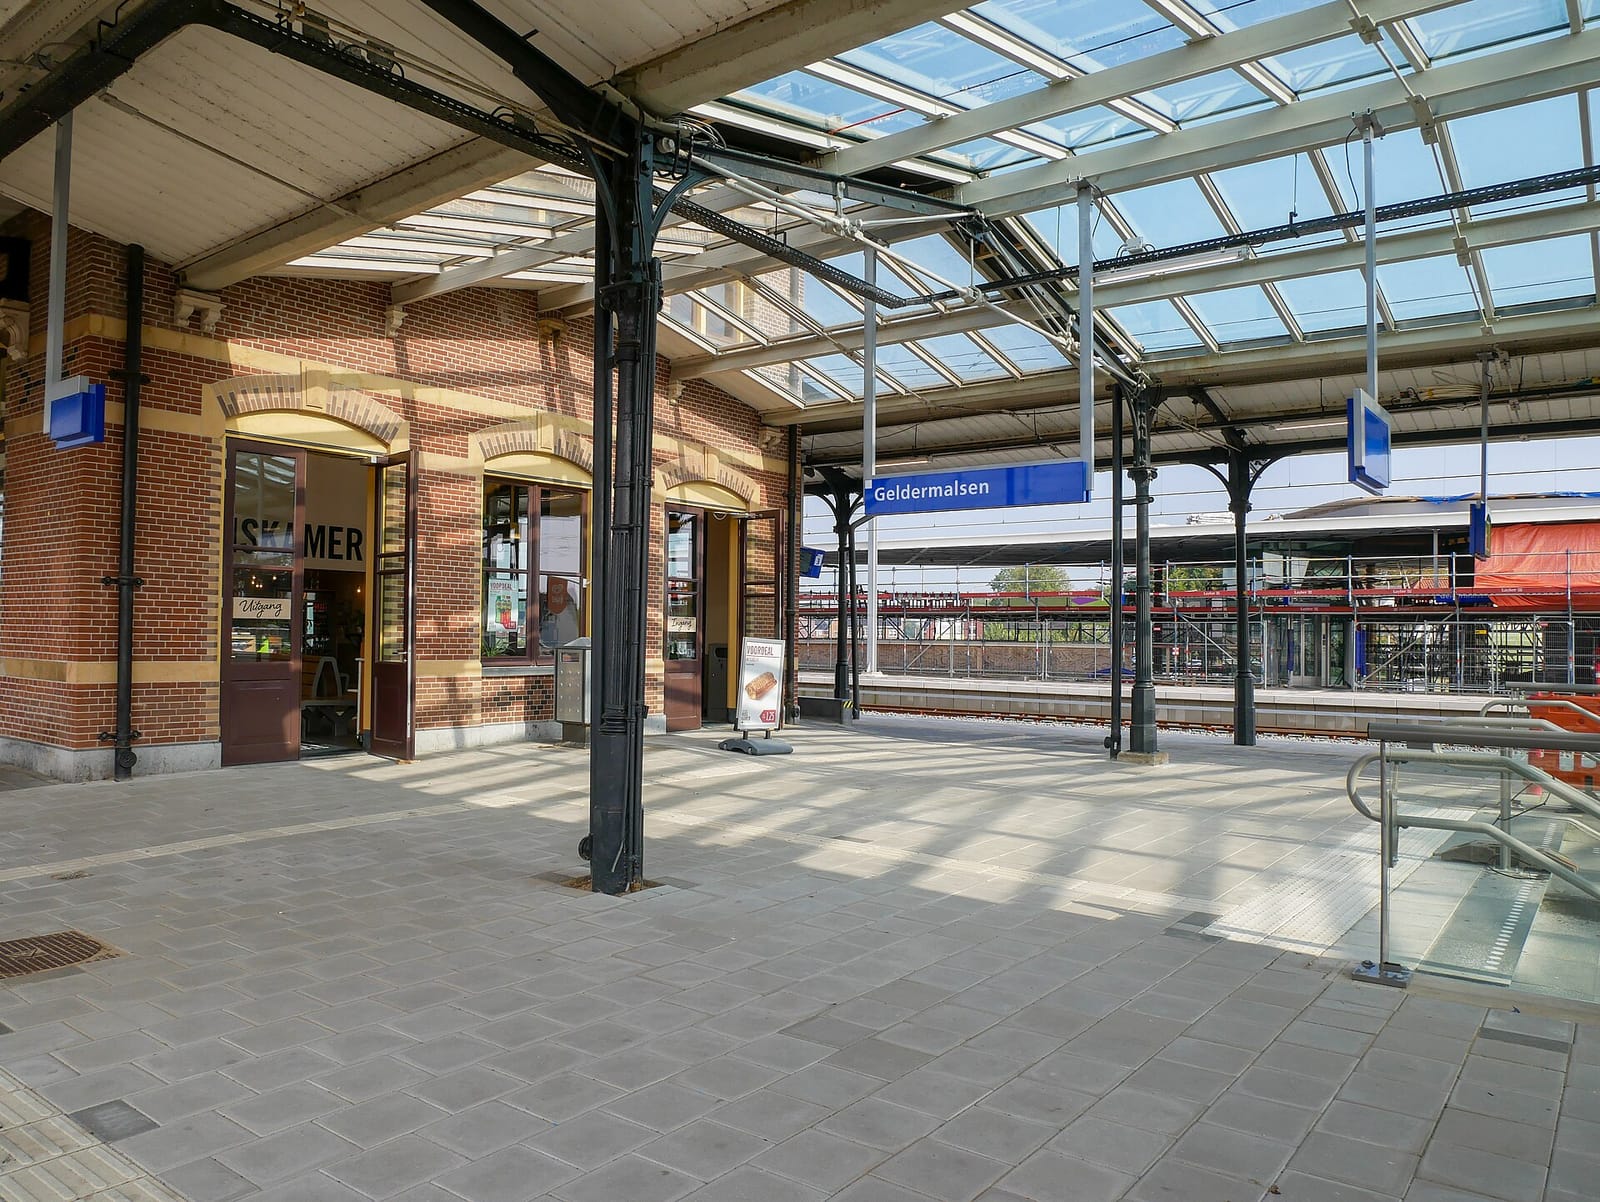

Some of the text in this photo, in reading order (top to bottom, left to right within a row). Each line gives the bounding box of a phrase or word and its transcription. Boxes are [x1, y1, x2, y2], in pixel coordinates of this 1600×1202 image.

[874, 480, 990, 502] Geldermalsen
[239, 599, 283, 618] Uitgang
[746, 645, 774, 656] VOORDEAL
